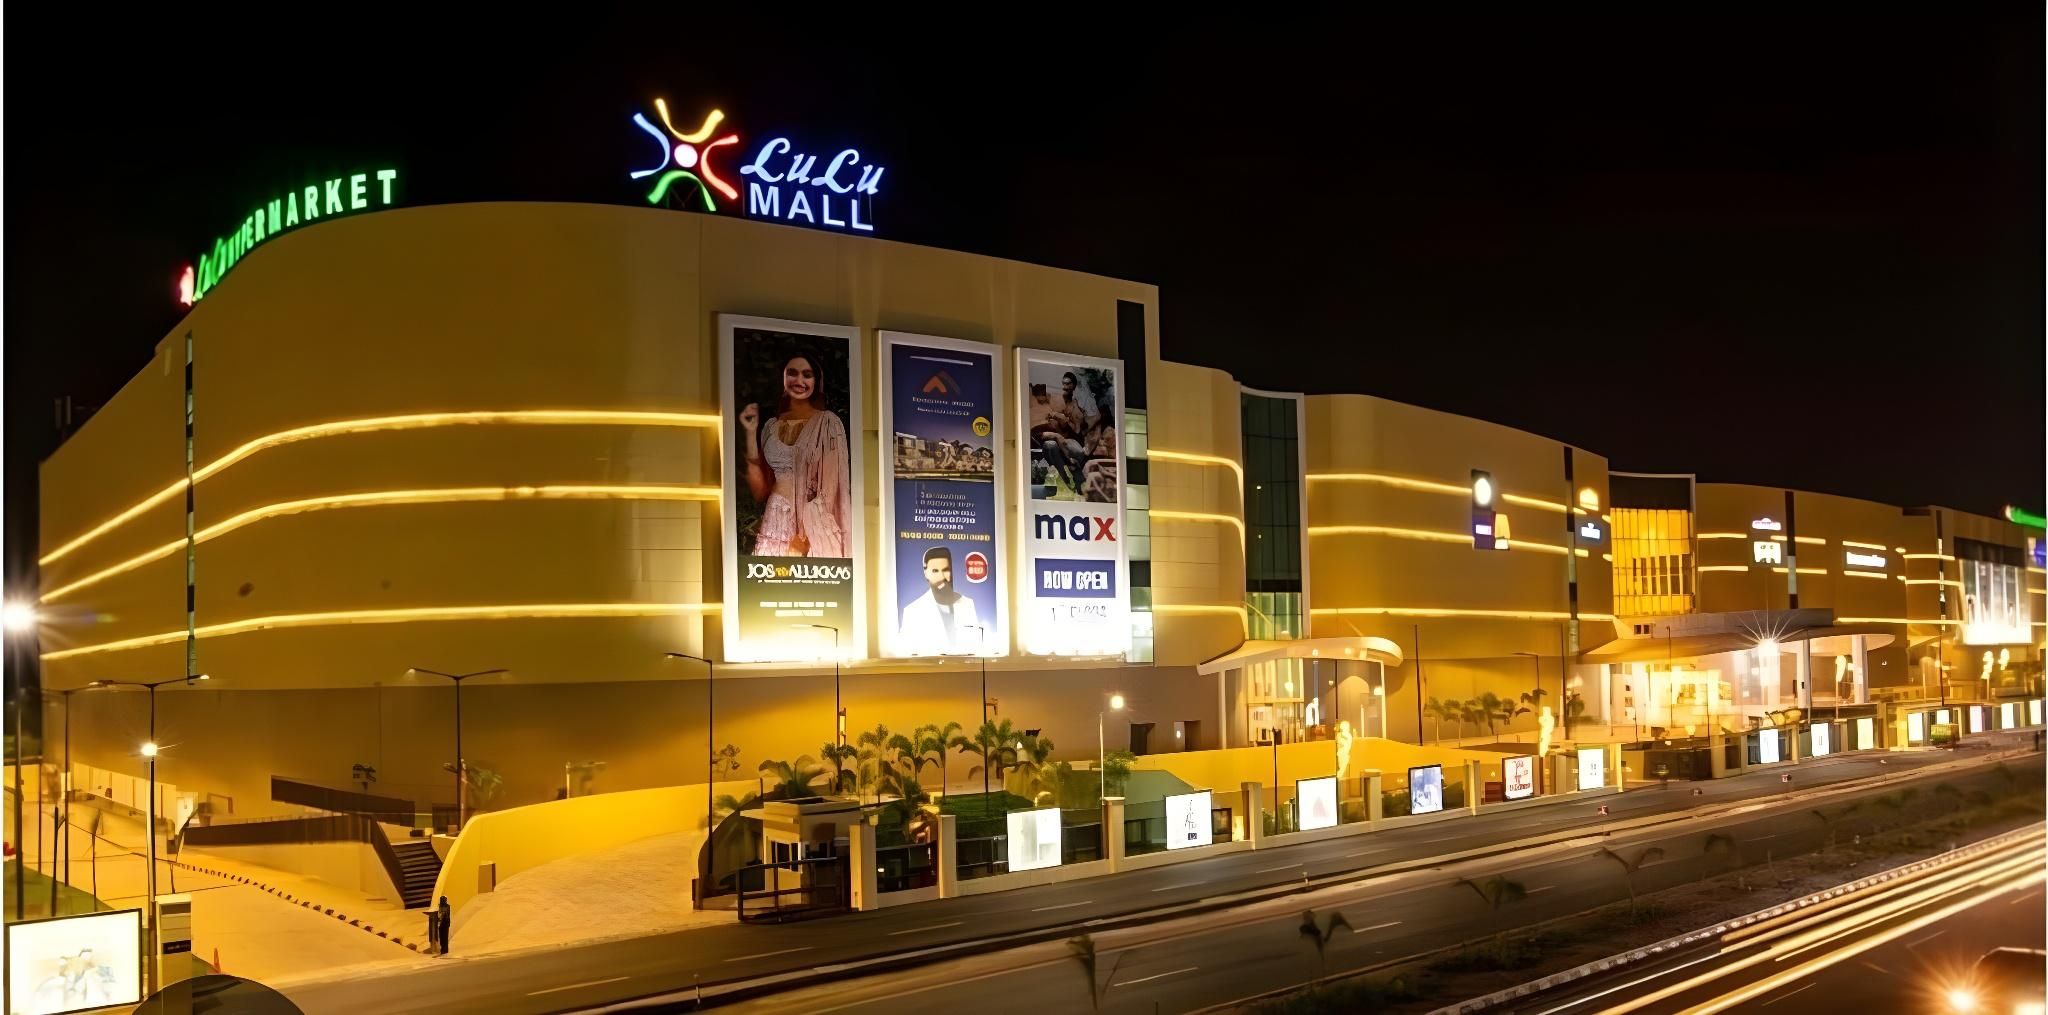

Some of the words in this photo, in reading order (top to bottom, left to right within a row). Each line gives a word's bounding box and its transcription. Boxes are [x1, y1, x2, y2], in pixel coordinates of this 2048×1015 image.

[739, 137, 885, 195] LuLu
[750, 182, 874, 231] MALL
[1035, 514, 1116, 541] max
[1043, 570, 1073, 590] NOW
[1076, 571, 1108, 590] OPEN
